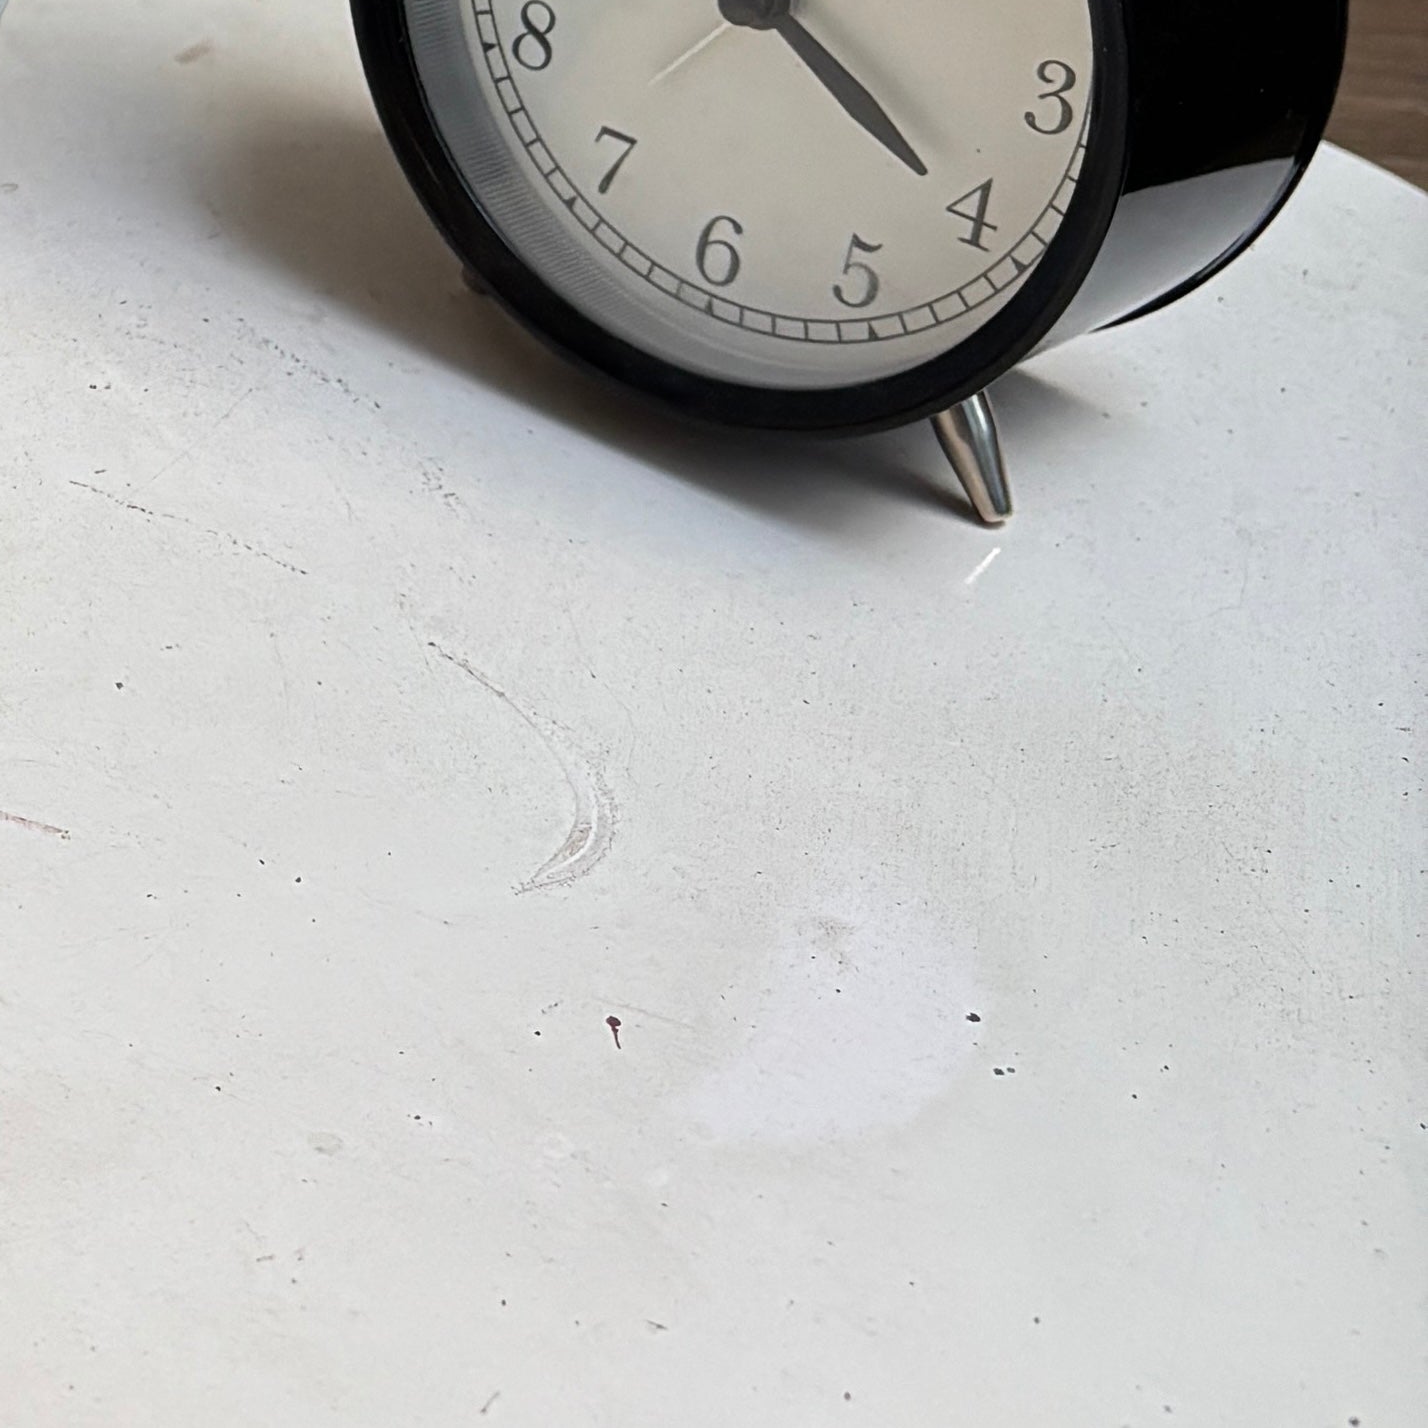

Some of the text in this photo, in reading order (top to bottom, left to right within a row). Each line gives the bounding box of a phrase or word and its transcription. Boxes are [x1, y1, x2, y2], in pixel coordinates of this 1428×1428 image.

[1024, 58, 1077, 135] 3
[594, 125, 638, 195] 7
[695, 215, 744, 287] 6
[945, 177, 999, 252] 4
[832, 233, 884, 309] 5
